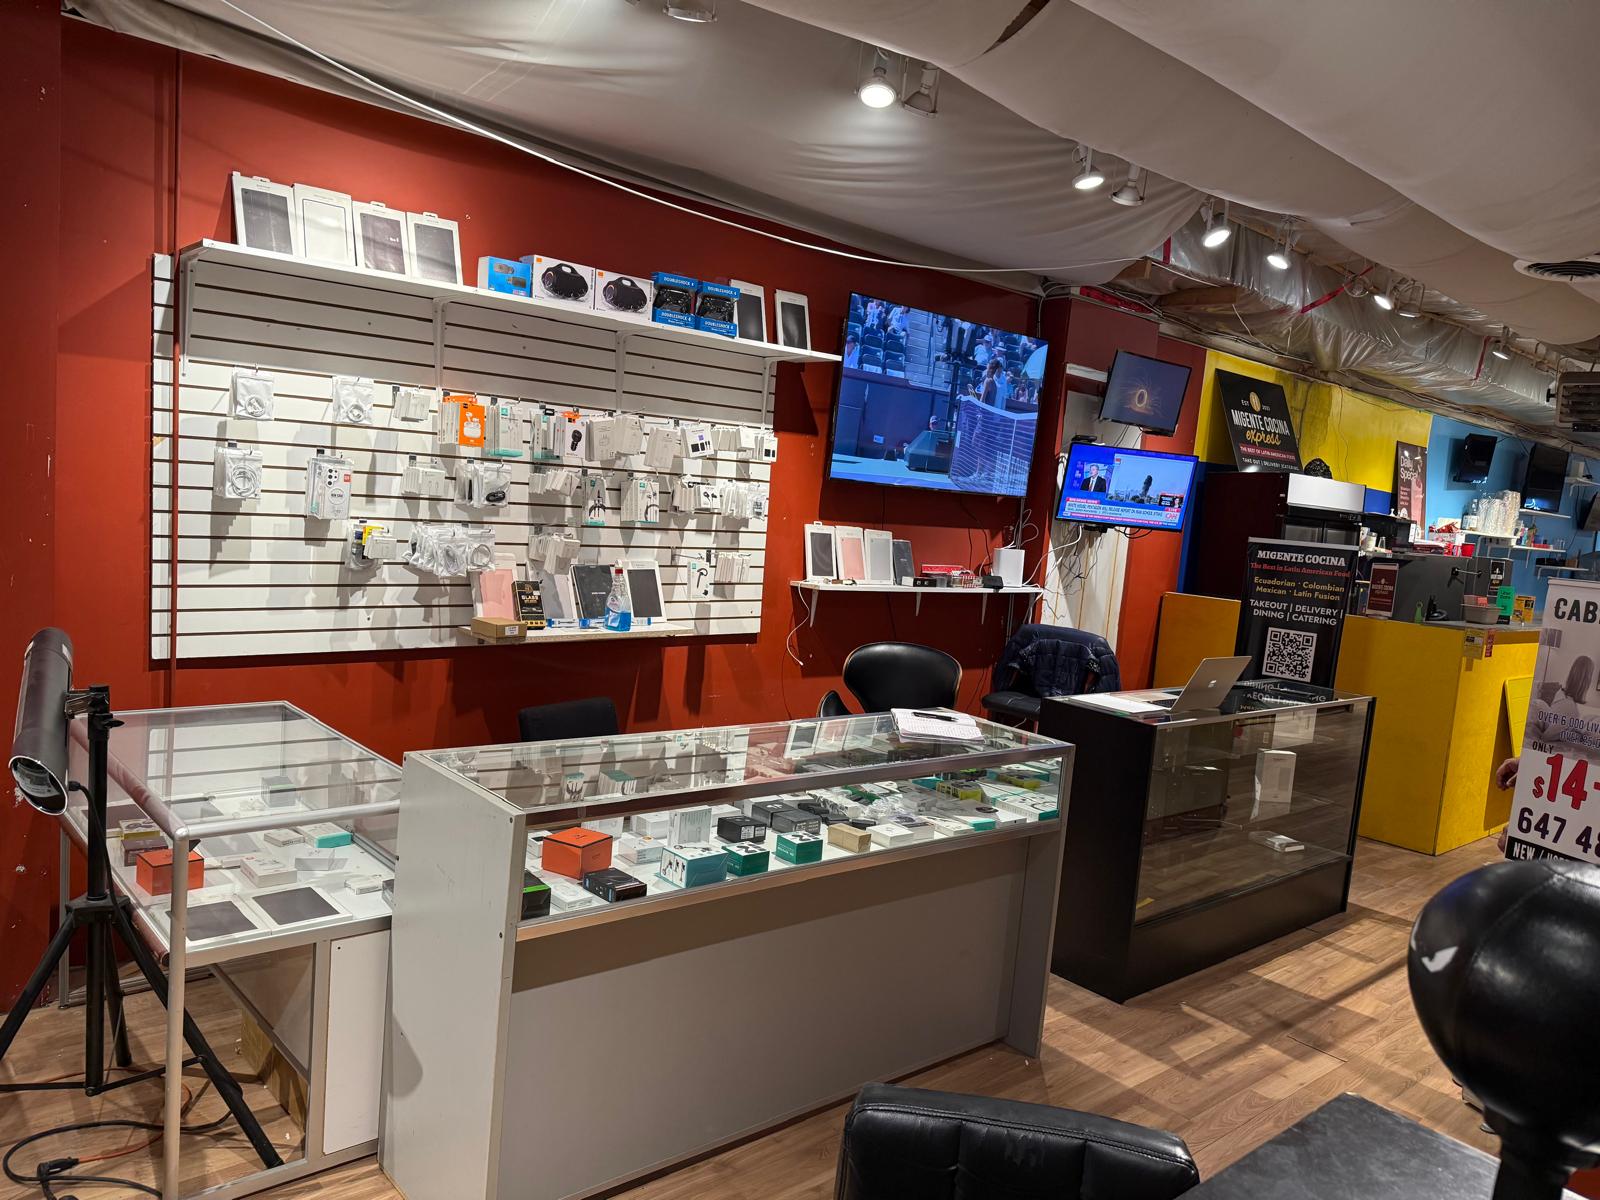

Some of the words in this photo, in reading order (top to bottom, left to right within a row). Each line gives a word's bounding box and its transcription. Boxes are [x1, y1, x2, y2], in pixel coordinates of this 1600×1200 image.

[1231, 409, 1264, 430] MIGENTE
[1264, 416, 1290, 436] COCINA
[1246, 430, 1281, 446] express
[1258, 550, 1304, 563] MIGENTE
[1305, 555, 1345, 566] COCINA
[1301, 567, 1333, 576] American
[1254, 576, 1295, 587] Ecuadorian
[1303, 582, 1344, 592] Colombian
[1256, 586, 1286, 595] Mexican
[1293, 590, 1312, 598] Latin
[1314, 592, 1340, 600] Fusion
[1250, 599, 1288, 610] TAKEOUT
[1295, 605, 1338, 616] DELIVERY
[1554, 598, 1600, 624] CAB
[1253, 609, 1284, 618] DINING
[1292, 613, 1337, 625] CATERING
[1538, 711, 1559, 724] OVER
[1587, 721, 1600, 734] LIV
[1532, 741, 1554, 754] ONLY
[1518, 807, 1566, 844] 647
[1512, 841, 1535, 861] NEW
